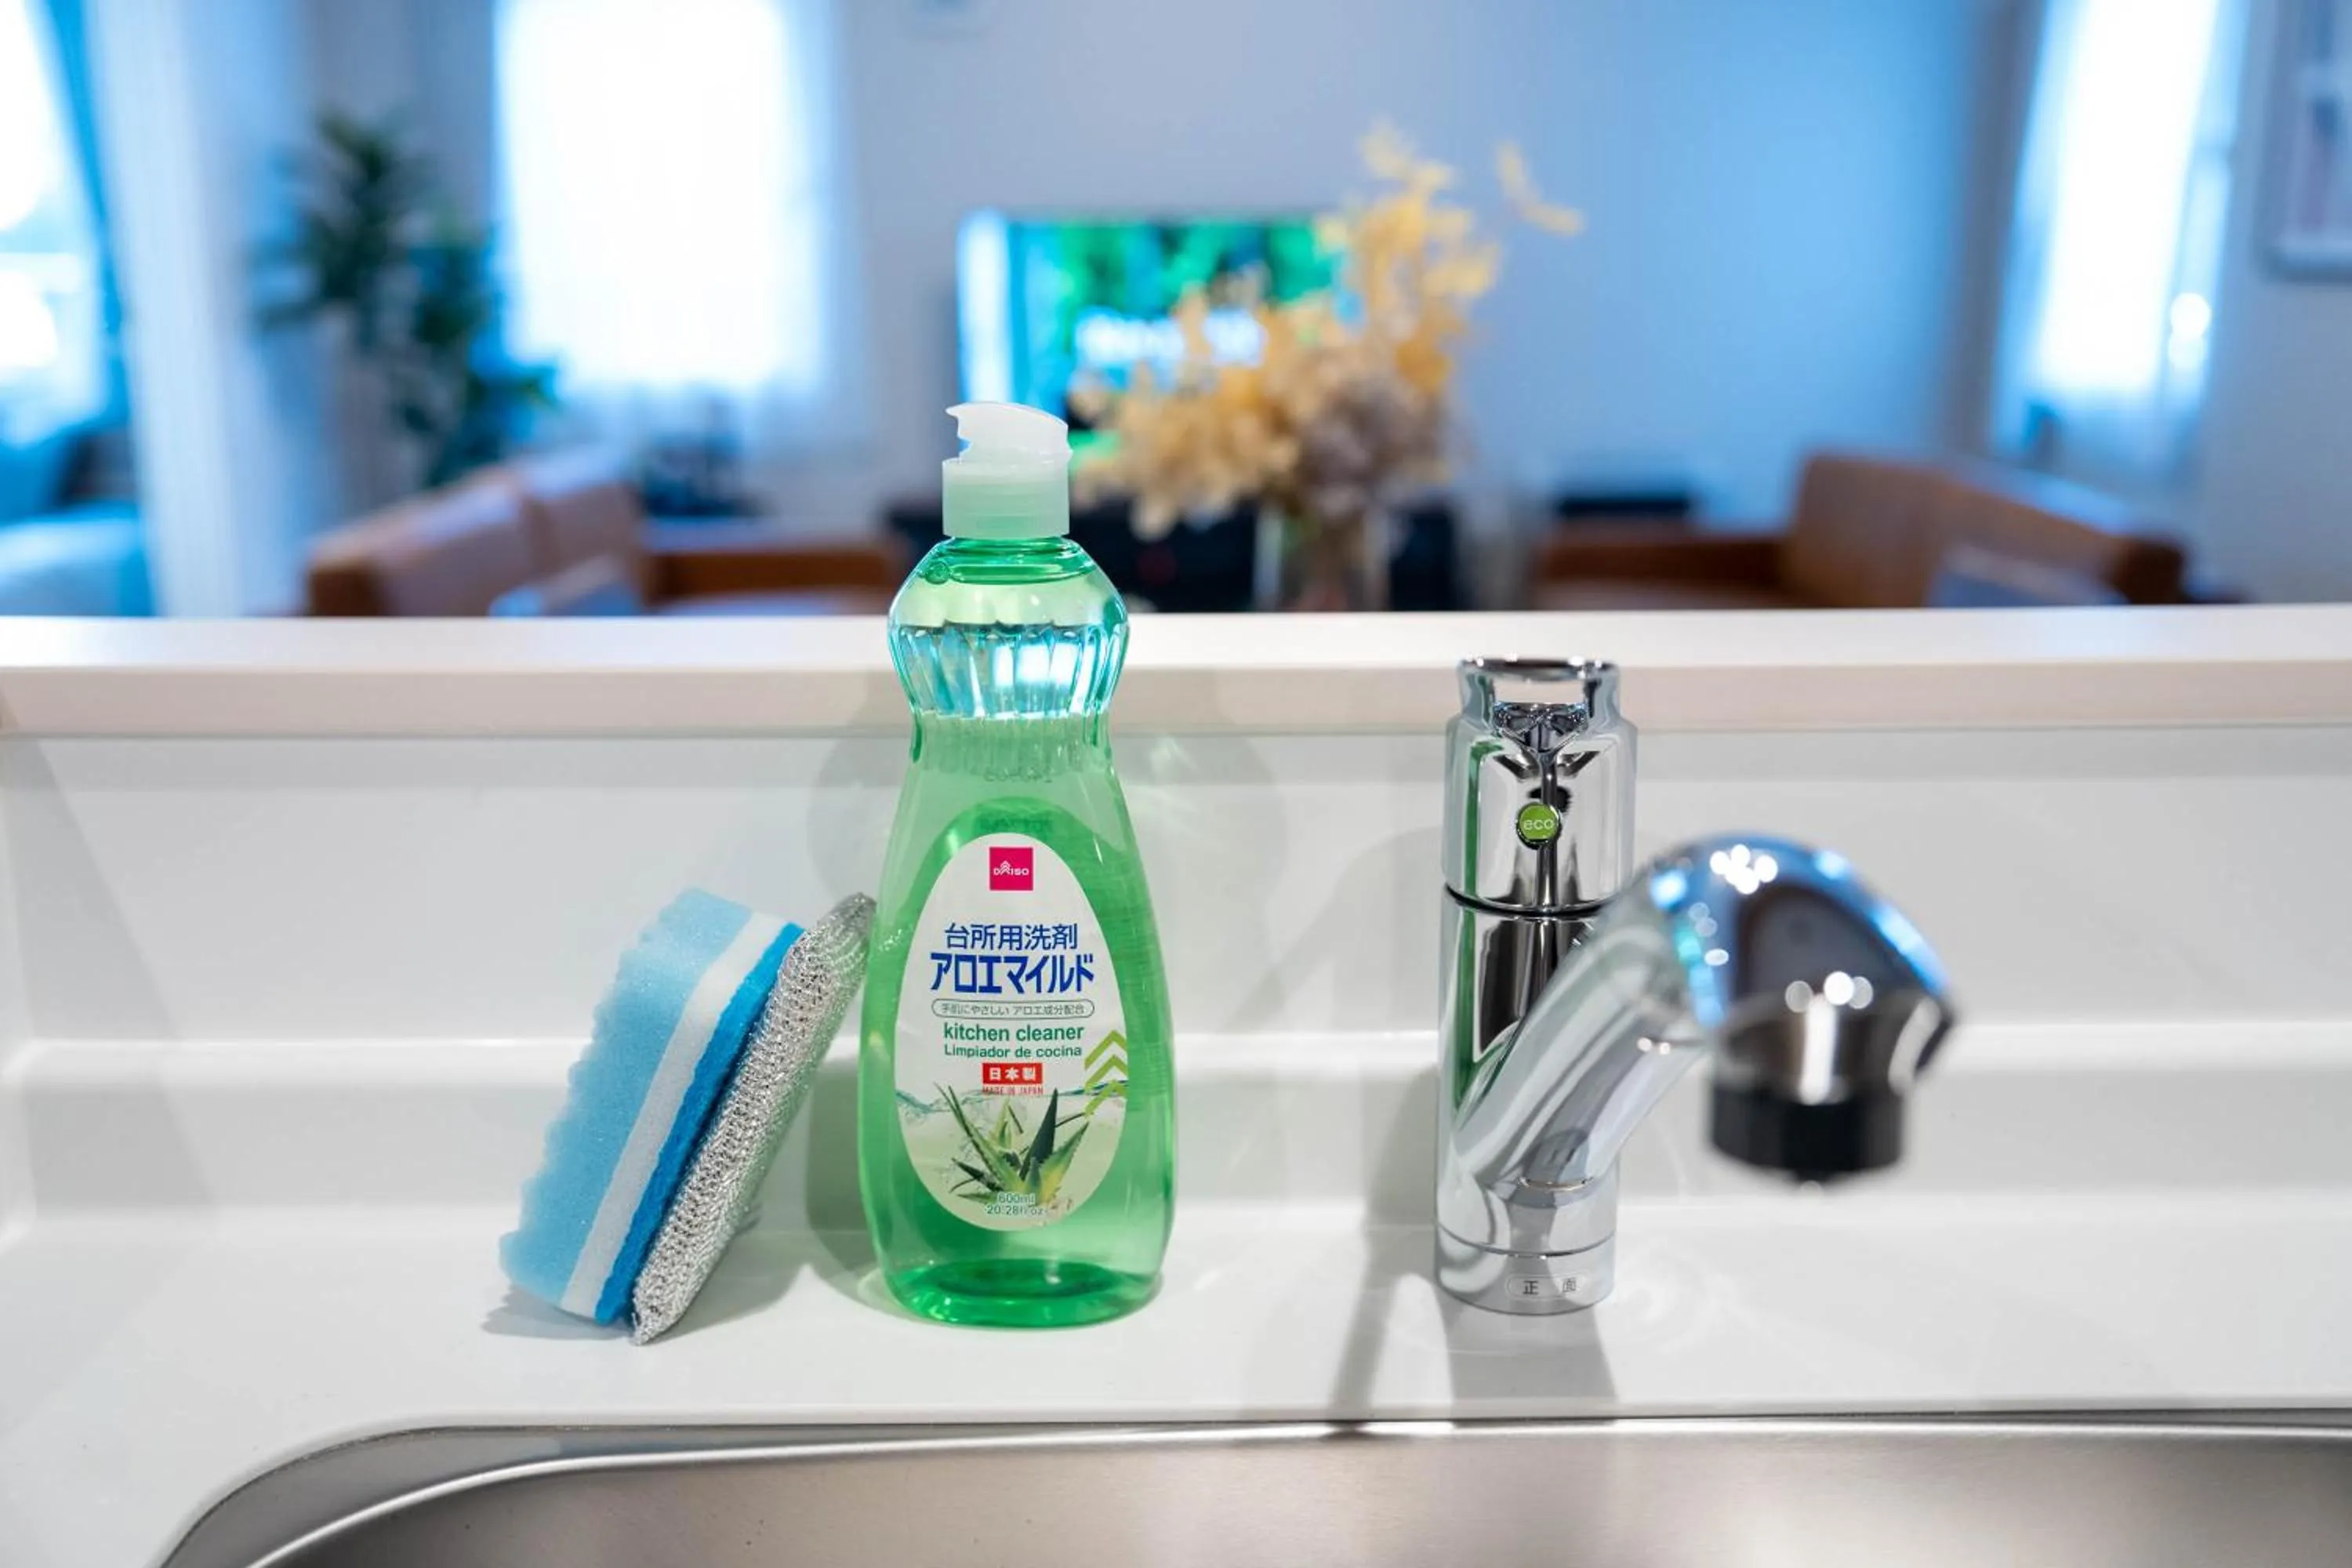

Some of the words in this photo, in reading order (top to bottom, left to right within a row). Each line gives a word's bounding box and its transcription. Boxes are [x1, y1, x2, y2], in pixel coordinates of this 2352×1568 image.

[1523, 818, 1554, 830] eco
[993, 860, 1029, 876] DAISO
[944, 923, 1079, 951] 台所用洗剤
[930, 953, 1095, 994] アロエマイルド
[944, 1022, 1010, 1042] kitchen
[1016, 1024, 1085, 1042] cleaner
[944, 1044, 1011, 1058] Limpiador
[1014, 1046, 1032, 1058] de
[1036, 1045, 1082, 1058] cocina
[989, 1066, 1036, 1081] 日本製
